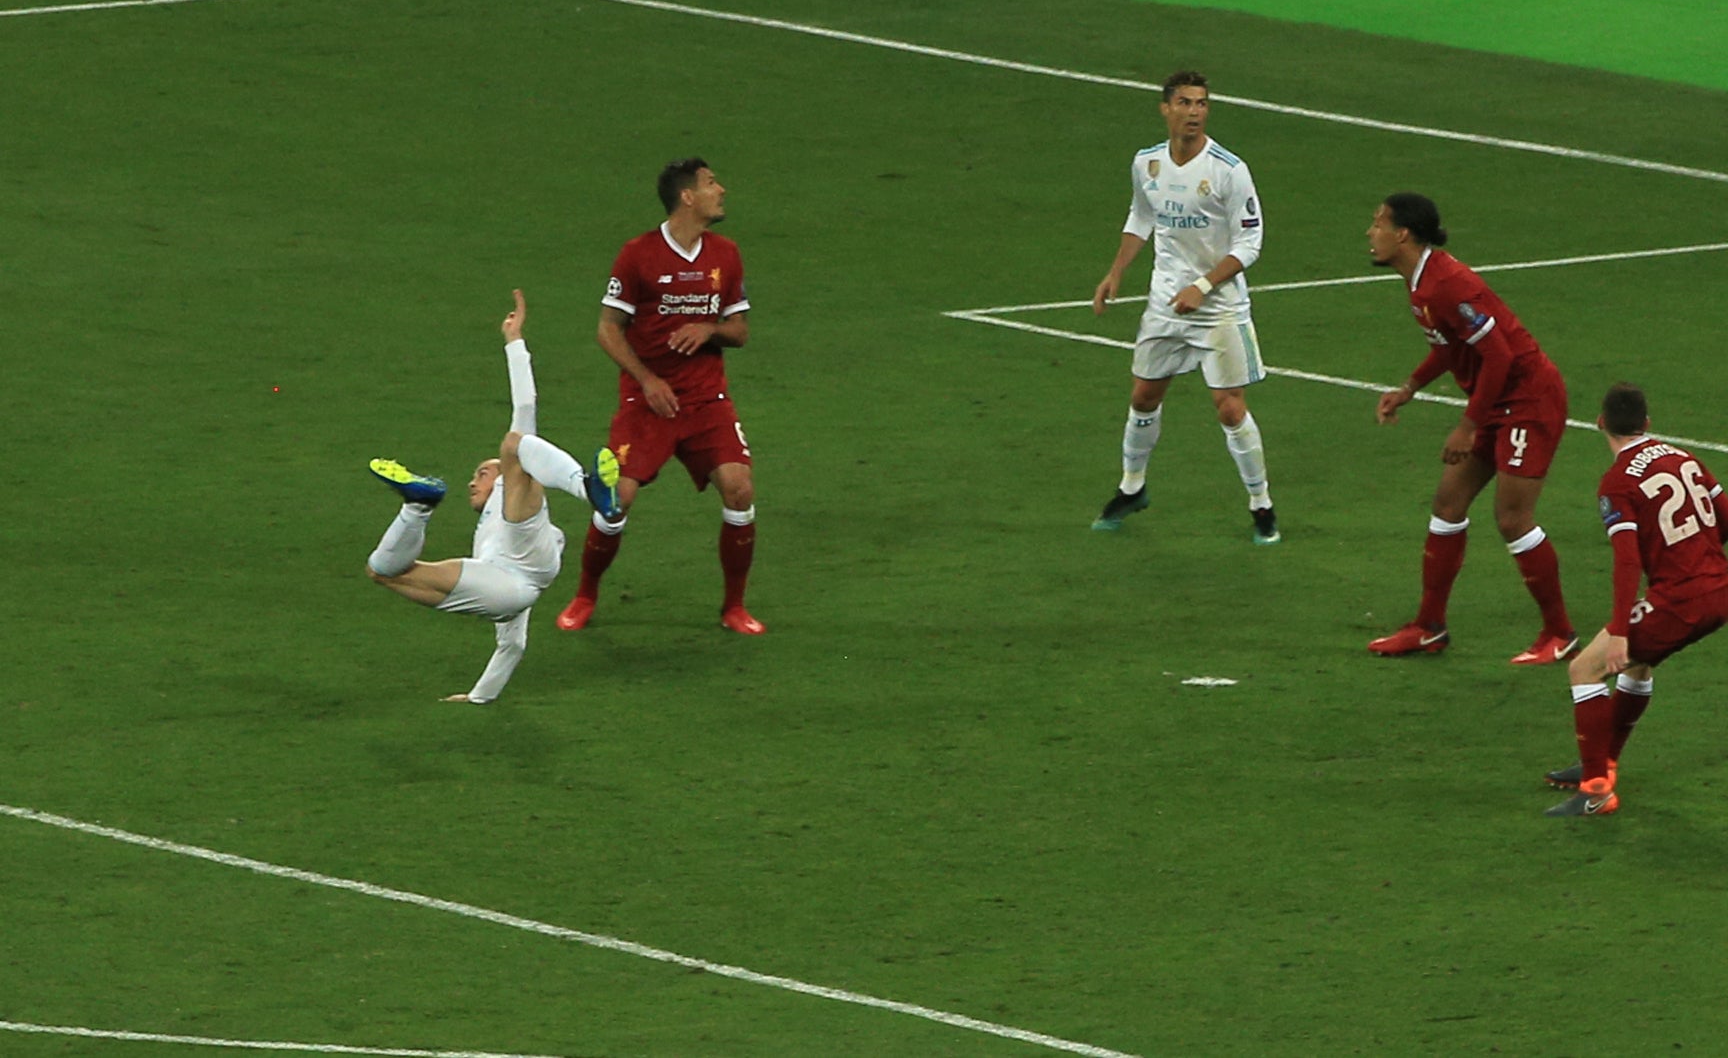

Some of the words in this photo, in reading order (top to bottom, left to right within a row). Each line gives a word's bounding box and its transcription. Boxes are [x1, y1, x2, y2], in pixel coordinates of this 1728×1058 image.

[662, 294, 709, 303] Standard
[657, 305, 708, 315] Chartered
[1510, 428, 1527, 457] 4
[1638, 460, 1717, 546] 26
